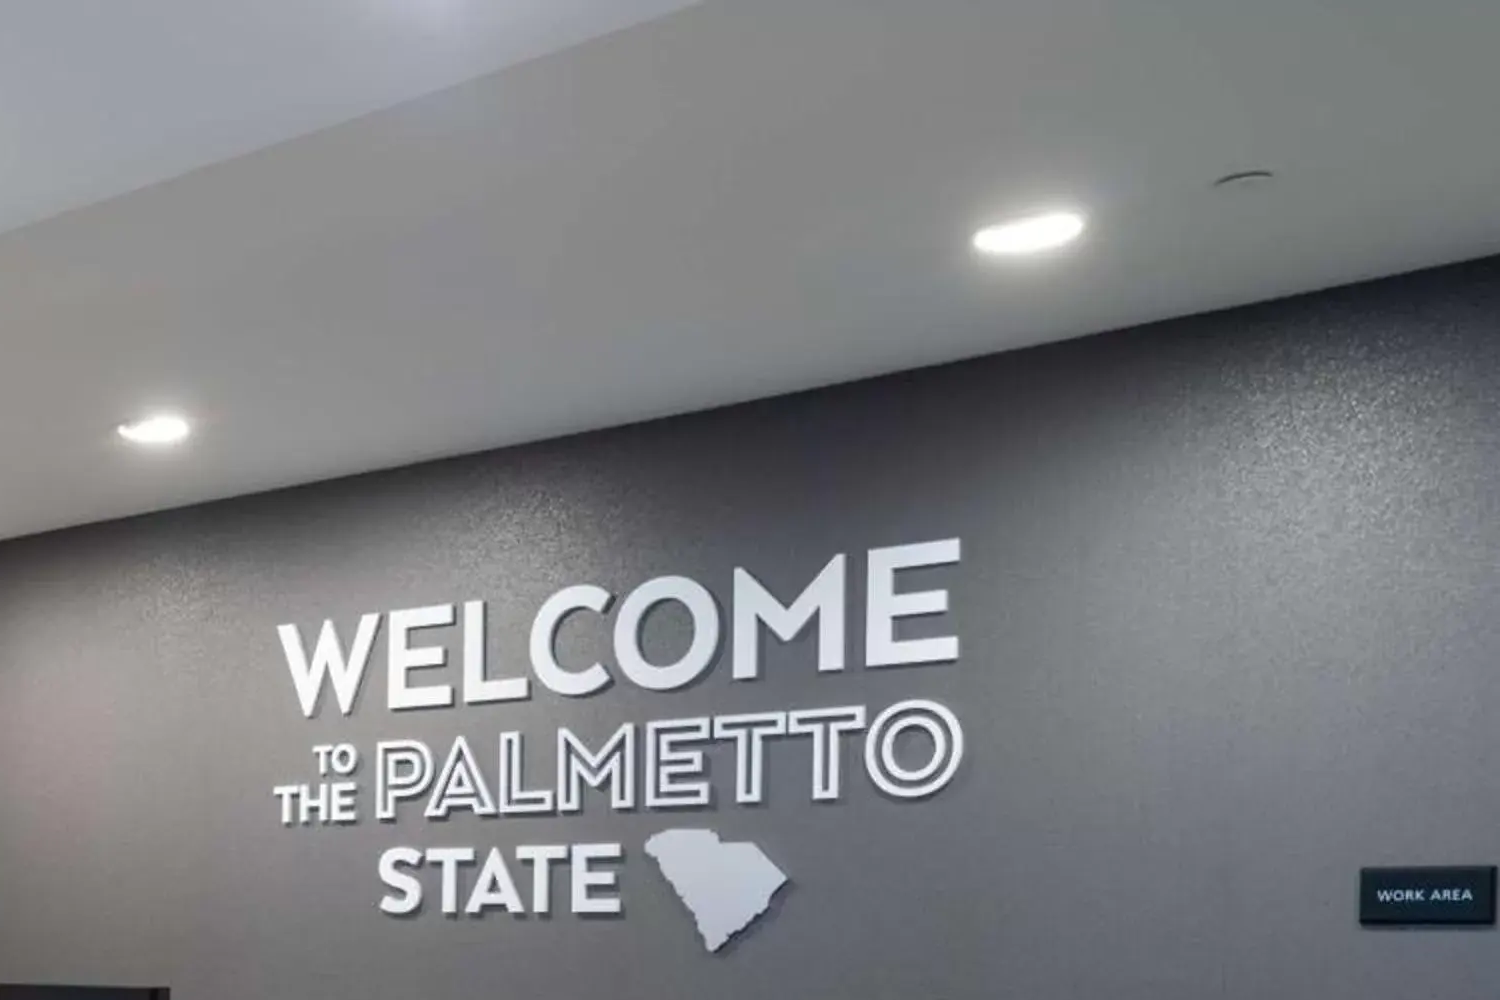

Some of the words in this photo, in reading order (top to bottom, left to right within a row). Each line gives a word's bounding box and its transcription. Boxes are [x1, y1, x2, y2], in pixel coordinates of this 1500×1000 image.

[276, 537, 962, 718] WELCOME
[273, 782, 357, 823] THE
[375, 699, 964, 820] PALMETTO
[312, 742, 357, 775] TO
[377, 842, 623, 915] STATE
[1376, 888, 1426, 903] WORK
[1429, 888, 1474, 902] AREA
